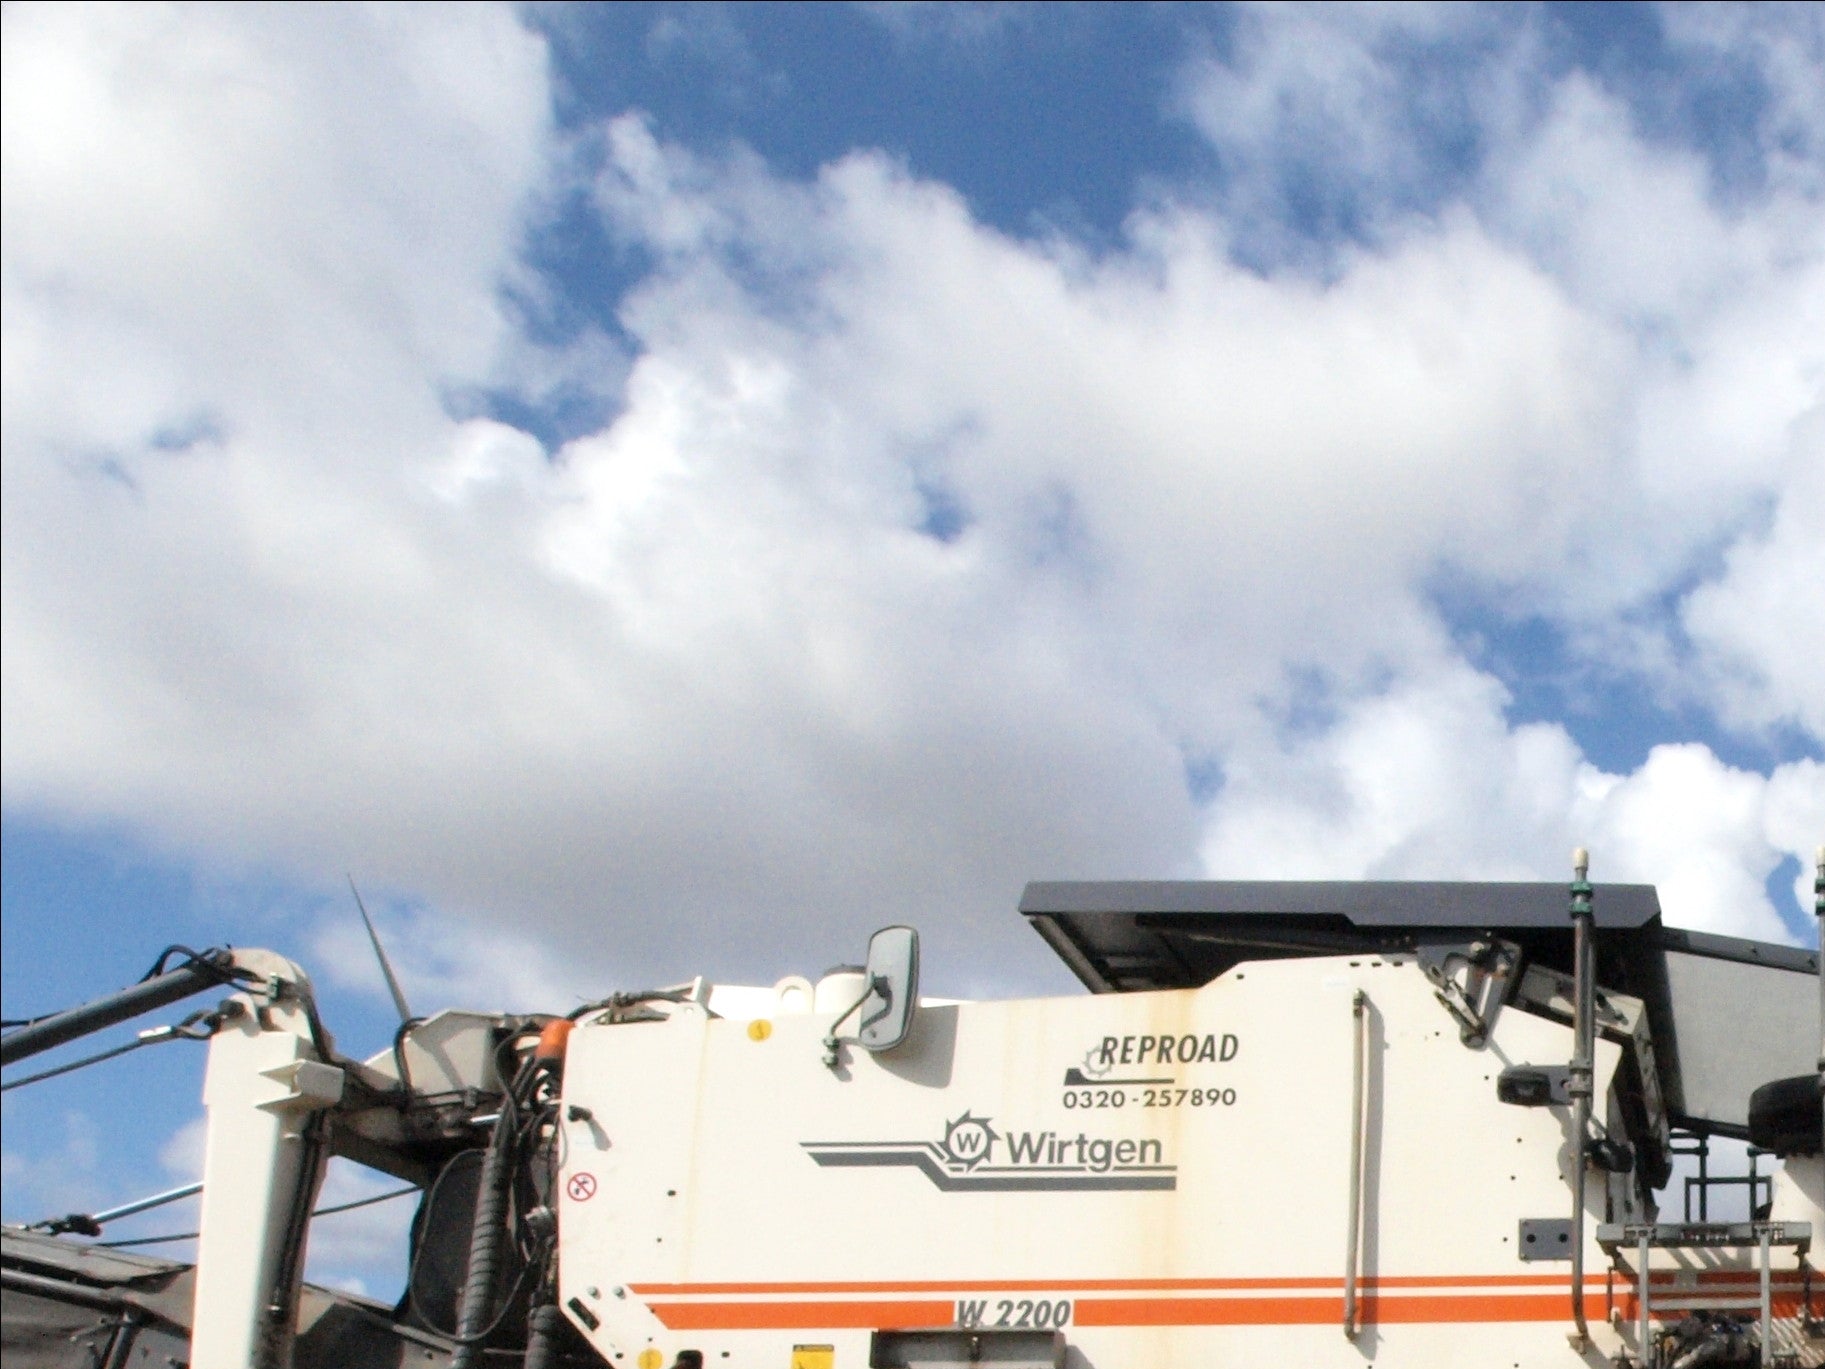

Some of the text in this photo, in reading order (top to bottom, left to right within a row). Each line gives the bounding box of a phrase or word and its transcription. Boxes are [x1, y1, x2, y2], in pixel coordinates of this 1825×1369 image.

[1099, 1034, 1239, 1065] REPROAD
[956, 1132, 1162, 1173] W Wirtgen
[957, 1299, 1072, 1328] W 2200
